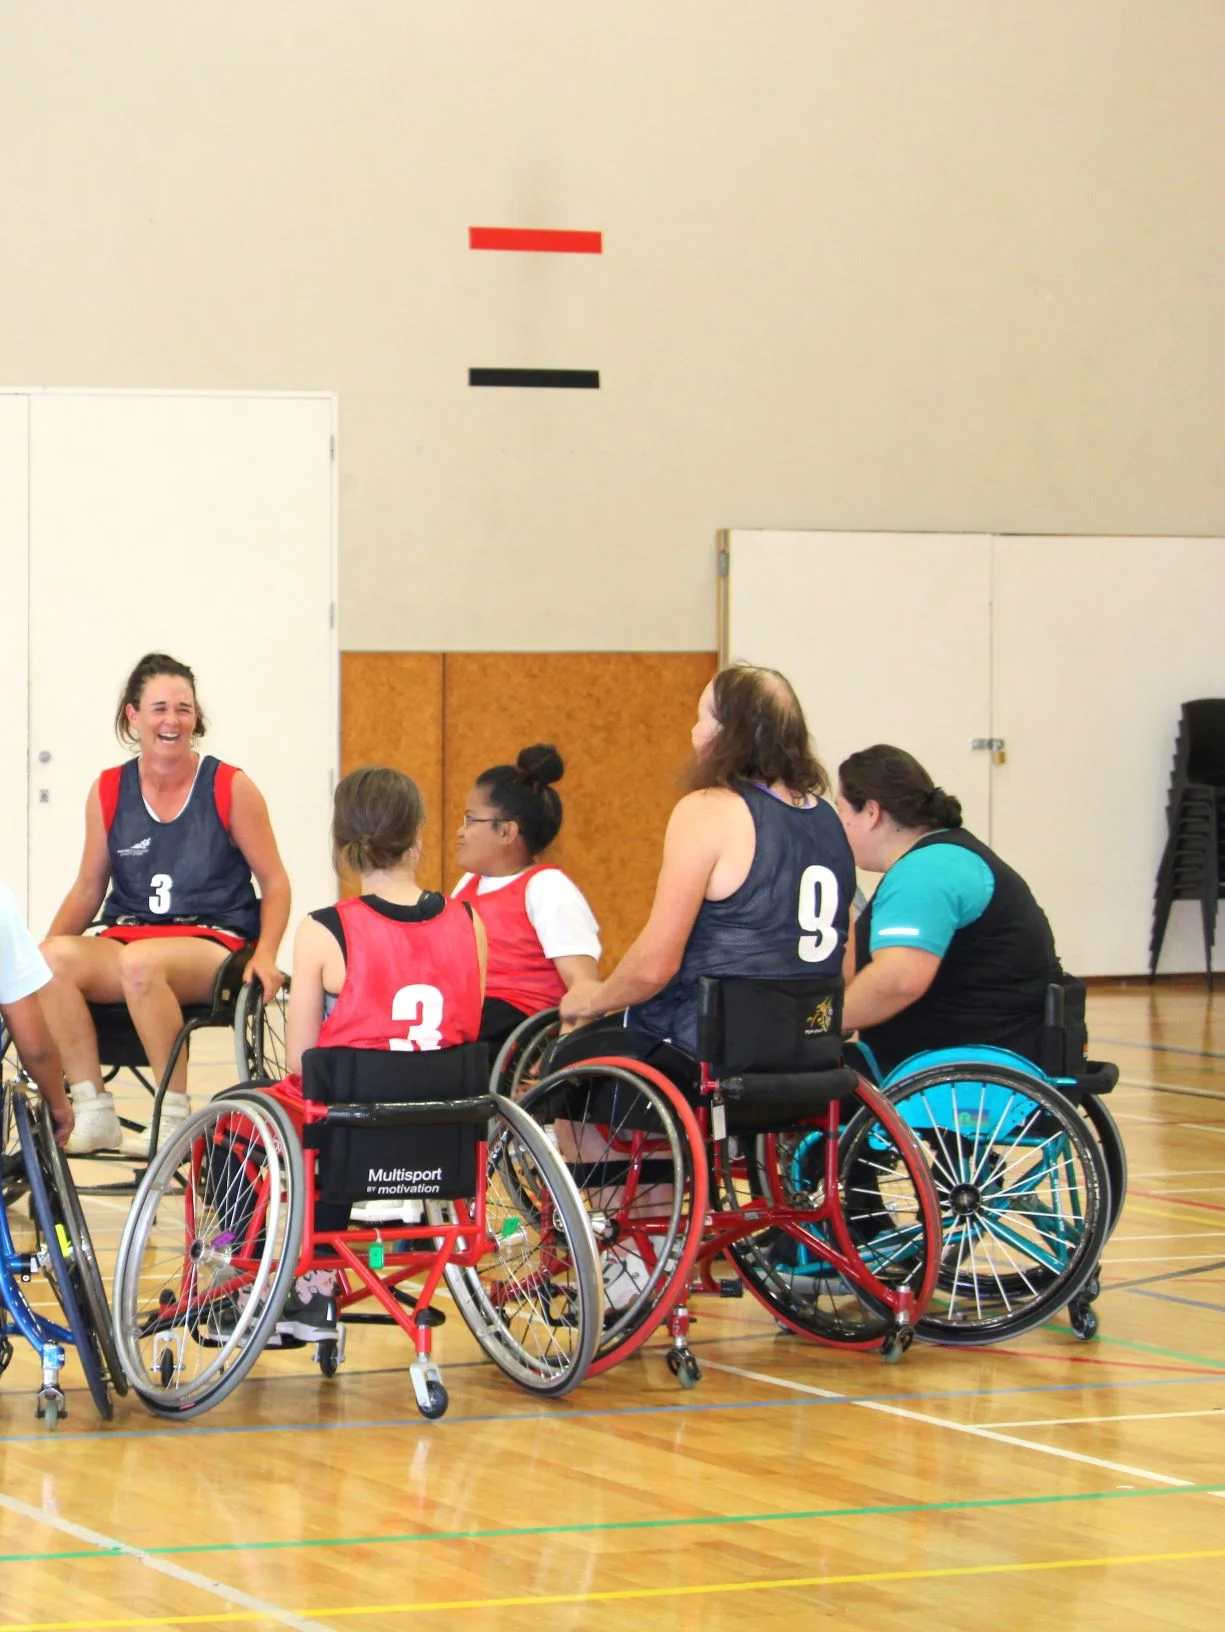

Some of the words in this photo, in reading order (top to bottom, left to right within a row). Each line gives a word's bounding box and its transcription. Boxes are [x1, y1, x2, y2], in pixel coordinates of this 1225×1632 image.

[148, 873, 174, 915] 3
[797, 864, 839, 963] 9
[388, 985, 444, 1052] 3
[366, 1185, 376, 1193] BY
[377, 1183, 440, 1195] motivation
[368, 1167, 443, 1184] Multisport
